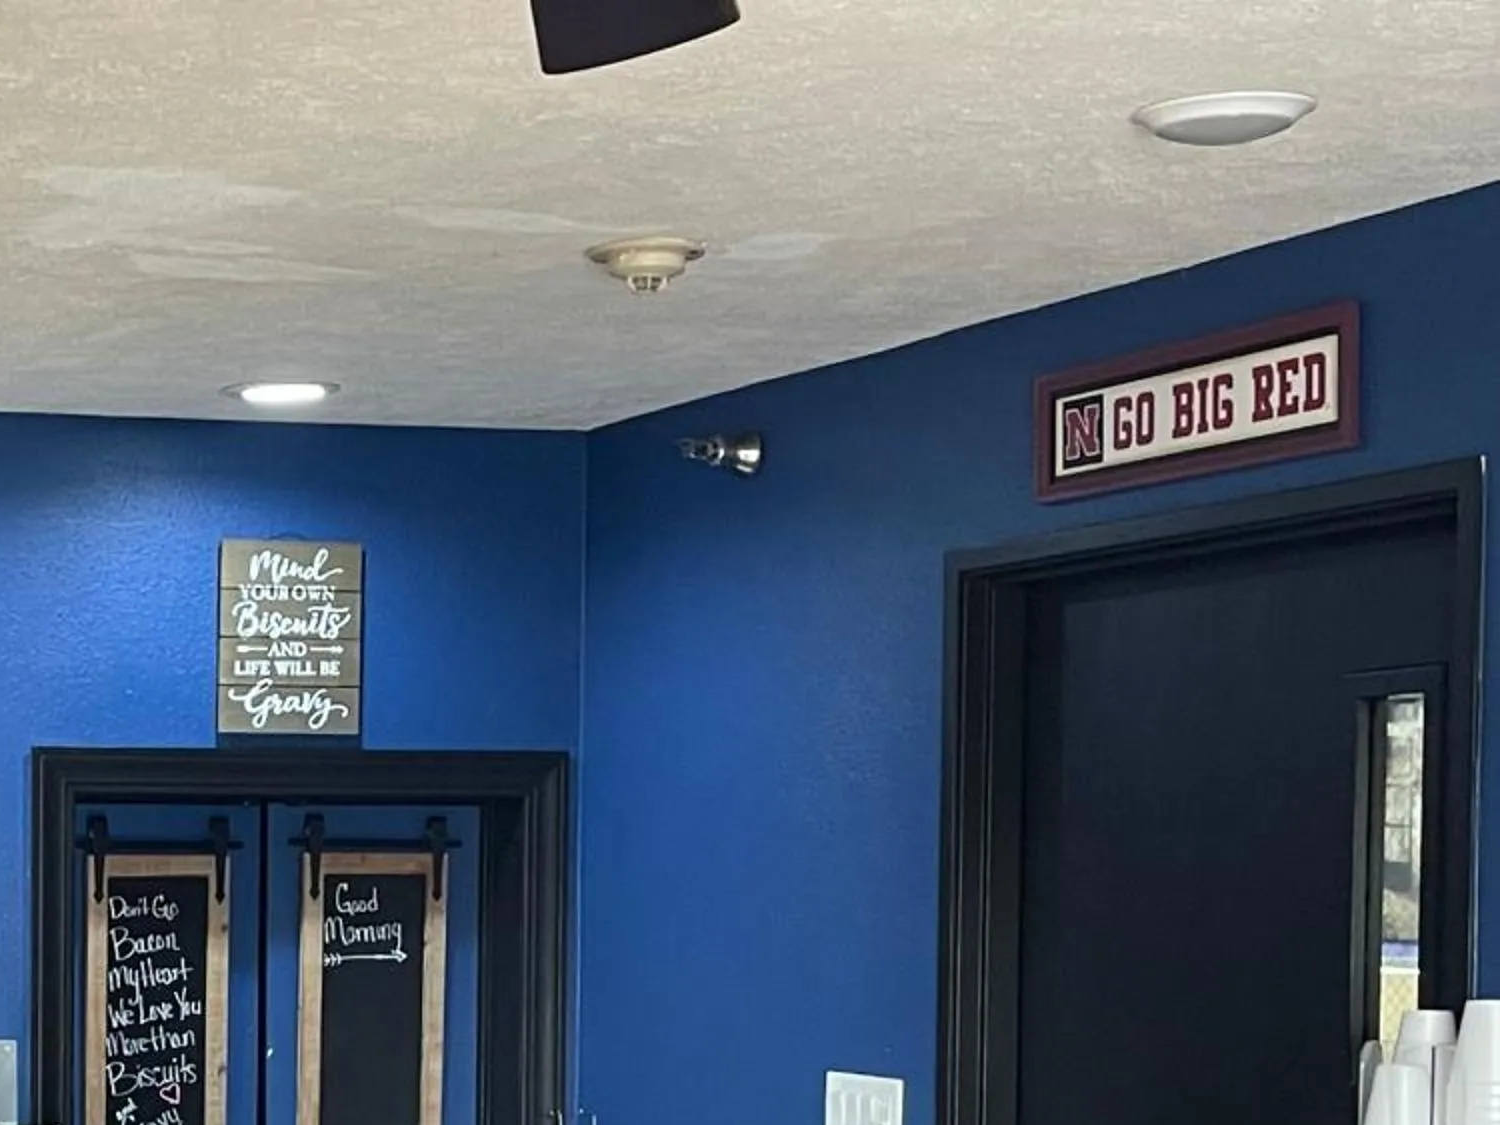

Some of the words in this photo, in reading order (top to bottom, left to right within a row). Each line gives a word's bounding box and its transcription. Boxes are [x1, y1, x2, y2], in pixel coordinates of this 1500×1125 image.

[1065, 403, 1101, 461] N
[1113, 391, 1155, 451] GO
[1172, 372, 1234, 439] BIG
[1252, 352, 1327, 423] RED
[250, 548, 344, 583] Mind
[239, 583, 290, 601] YOUR
[291, 584, 336, 601] OWN
[231, 601, 351, 640] Biscuits
[267, 641, 307, 657] AND
[234, 660, 271, 676] LIFE
[273, 660, 317, 676] WILL
[320, 661, 341, 676] BE
[228, 677, 349, 729] Gravy
[151, 894, 180, 921] Go
[335, 882, 379, 916] Good
[109, 925, 181, 961] Bacon
[323, 916, 402, 952] Morning
[139, 957, 195, 987] Heart
[107, 997, 135, 1029] We
[139, 994, 174, 1025] Love
[173, 986, 202, 1021] You
[105, 1053, 198, 1097] Biscuits
